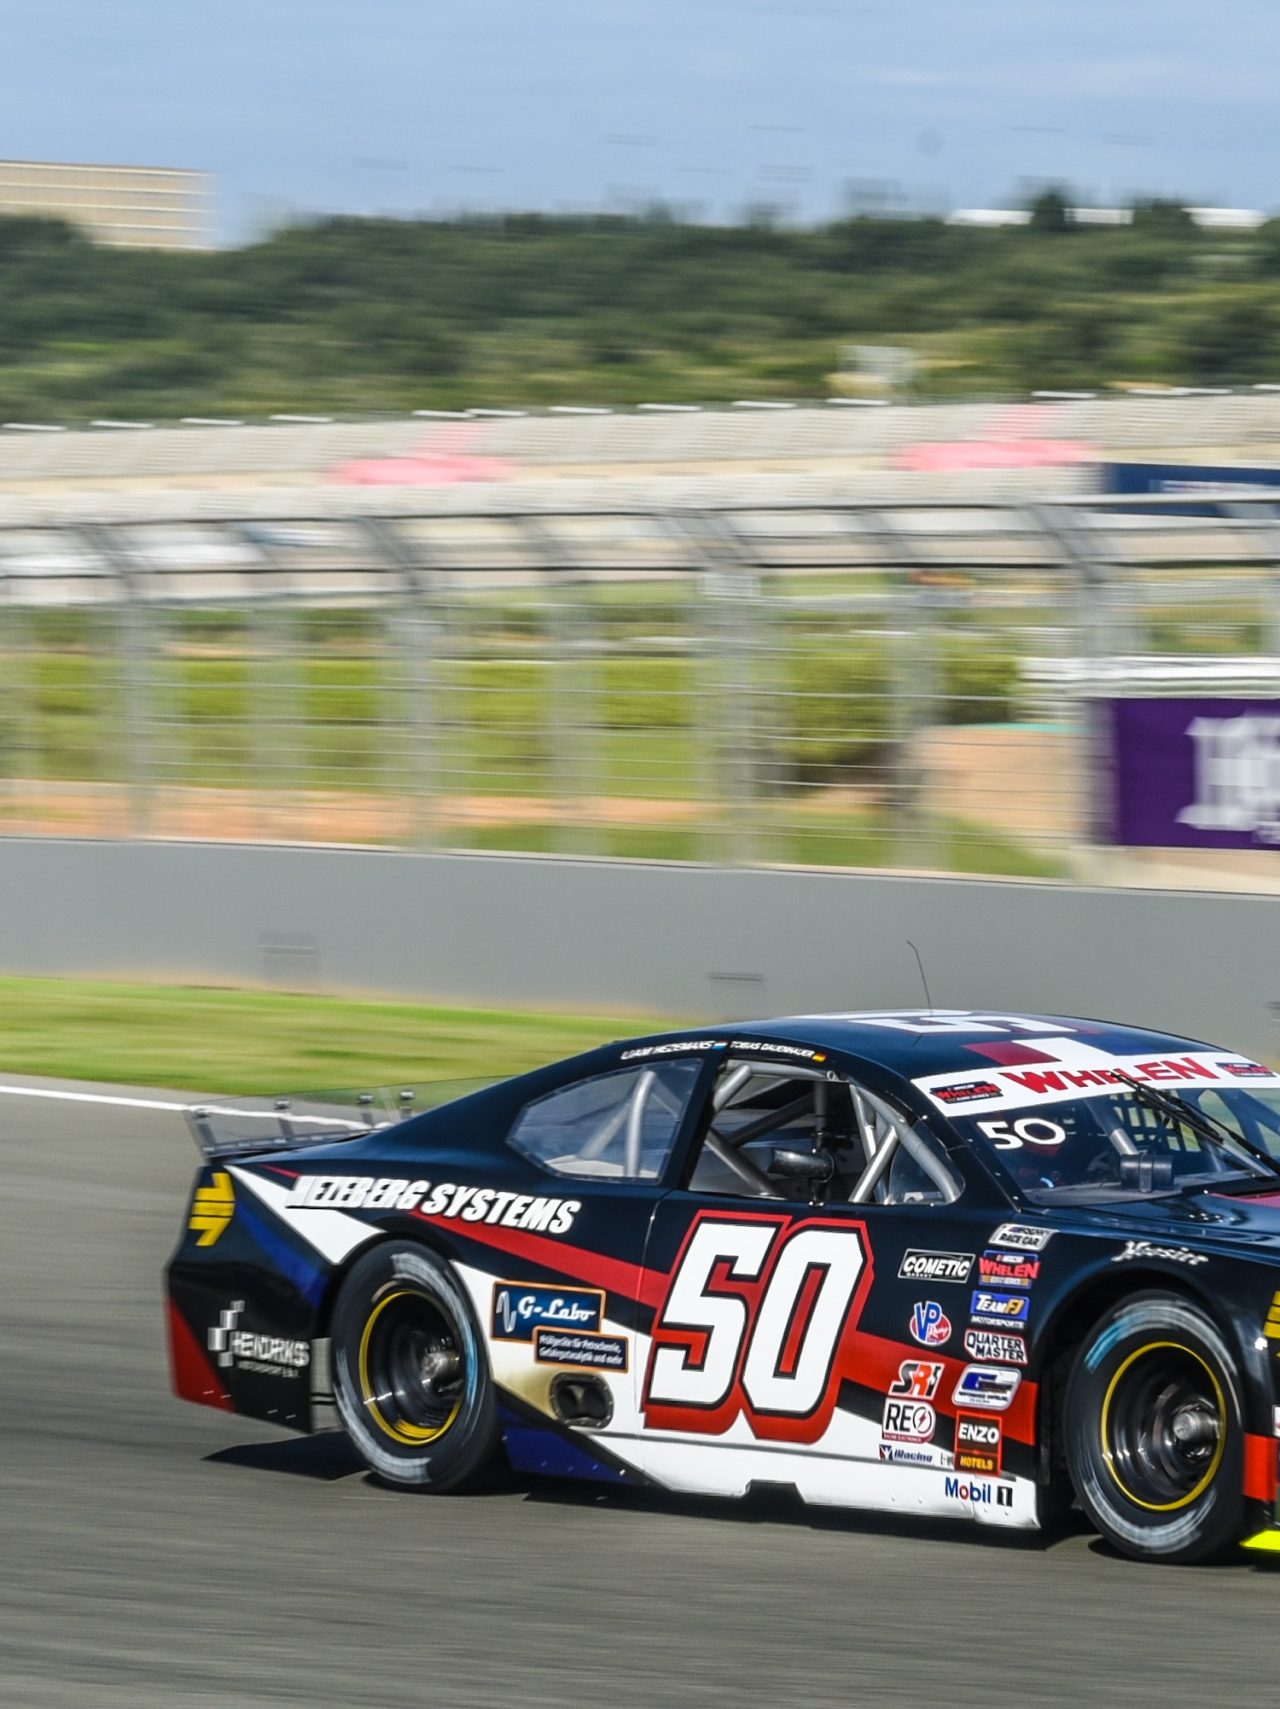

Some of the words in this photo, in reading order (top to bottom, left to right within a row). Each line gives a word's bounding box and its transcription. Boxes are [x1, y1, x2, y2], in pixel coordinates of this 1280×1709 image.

[998, 1057, 1220, 1094] WHELEN
[984, 1117, 1067, 1150] 50
[420, 1182, 582, 1235] SYSTEMS
[999, 1233, 1021, 1243] RACE
[1022, 1236, 1040, 1246] CAR
[903, 1256, 971, 1277] COMETIC
[979, 1257, 1041, 1279] WHELEN
[518, 1295, 597, 1322] G-Labo
[643, 1215, 869, 1424] 50
[914, 1300, 942, 1343] VP
[967, 1332, 1022, 1349] QUARTER
[975, 1344, 1024, 1362] MASTER
[958, 1423, 999, 1444] ENZO
[960, 1456, 994, 1471] HOTELS
[945, 1477, 991, 1503] Mobil
